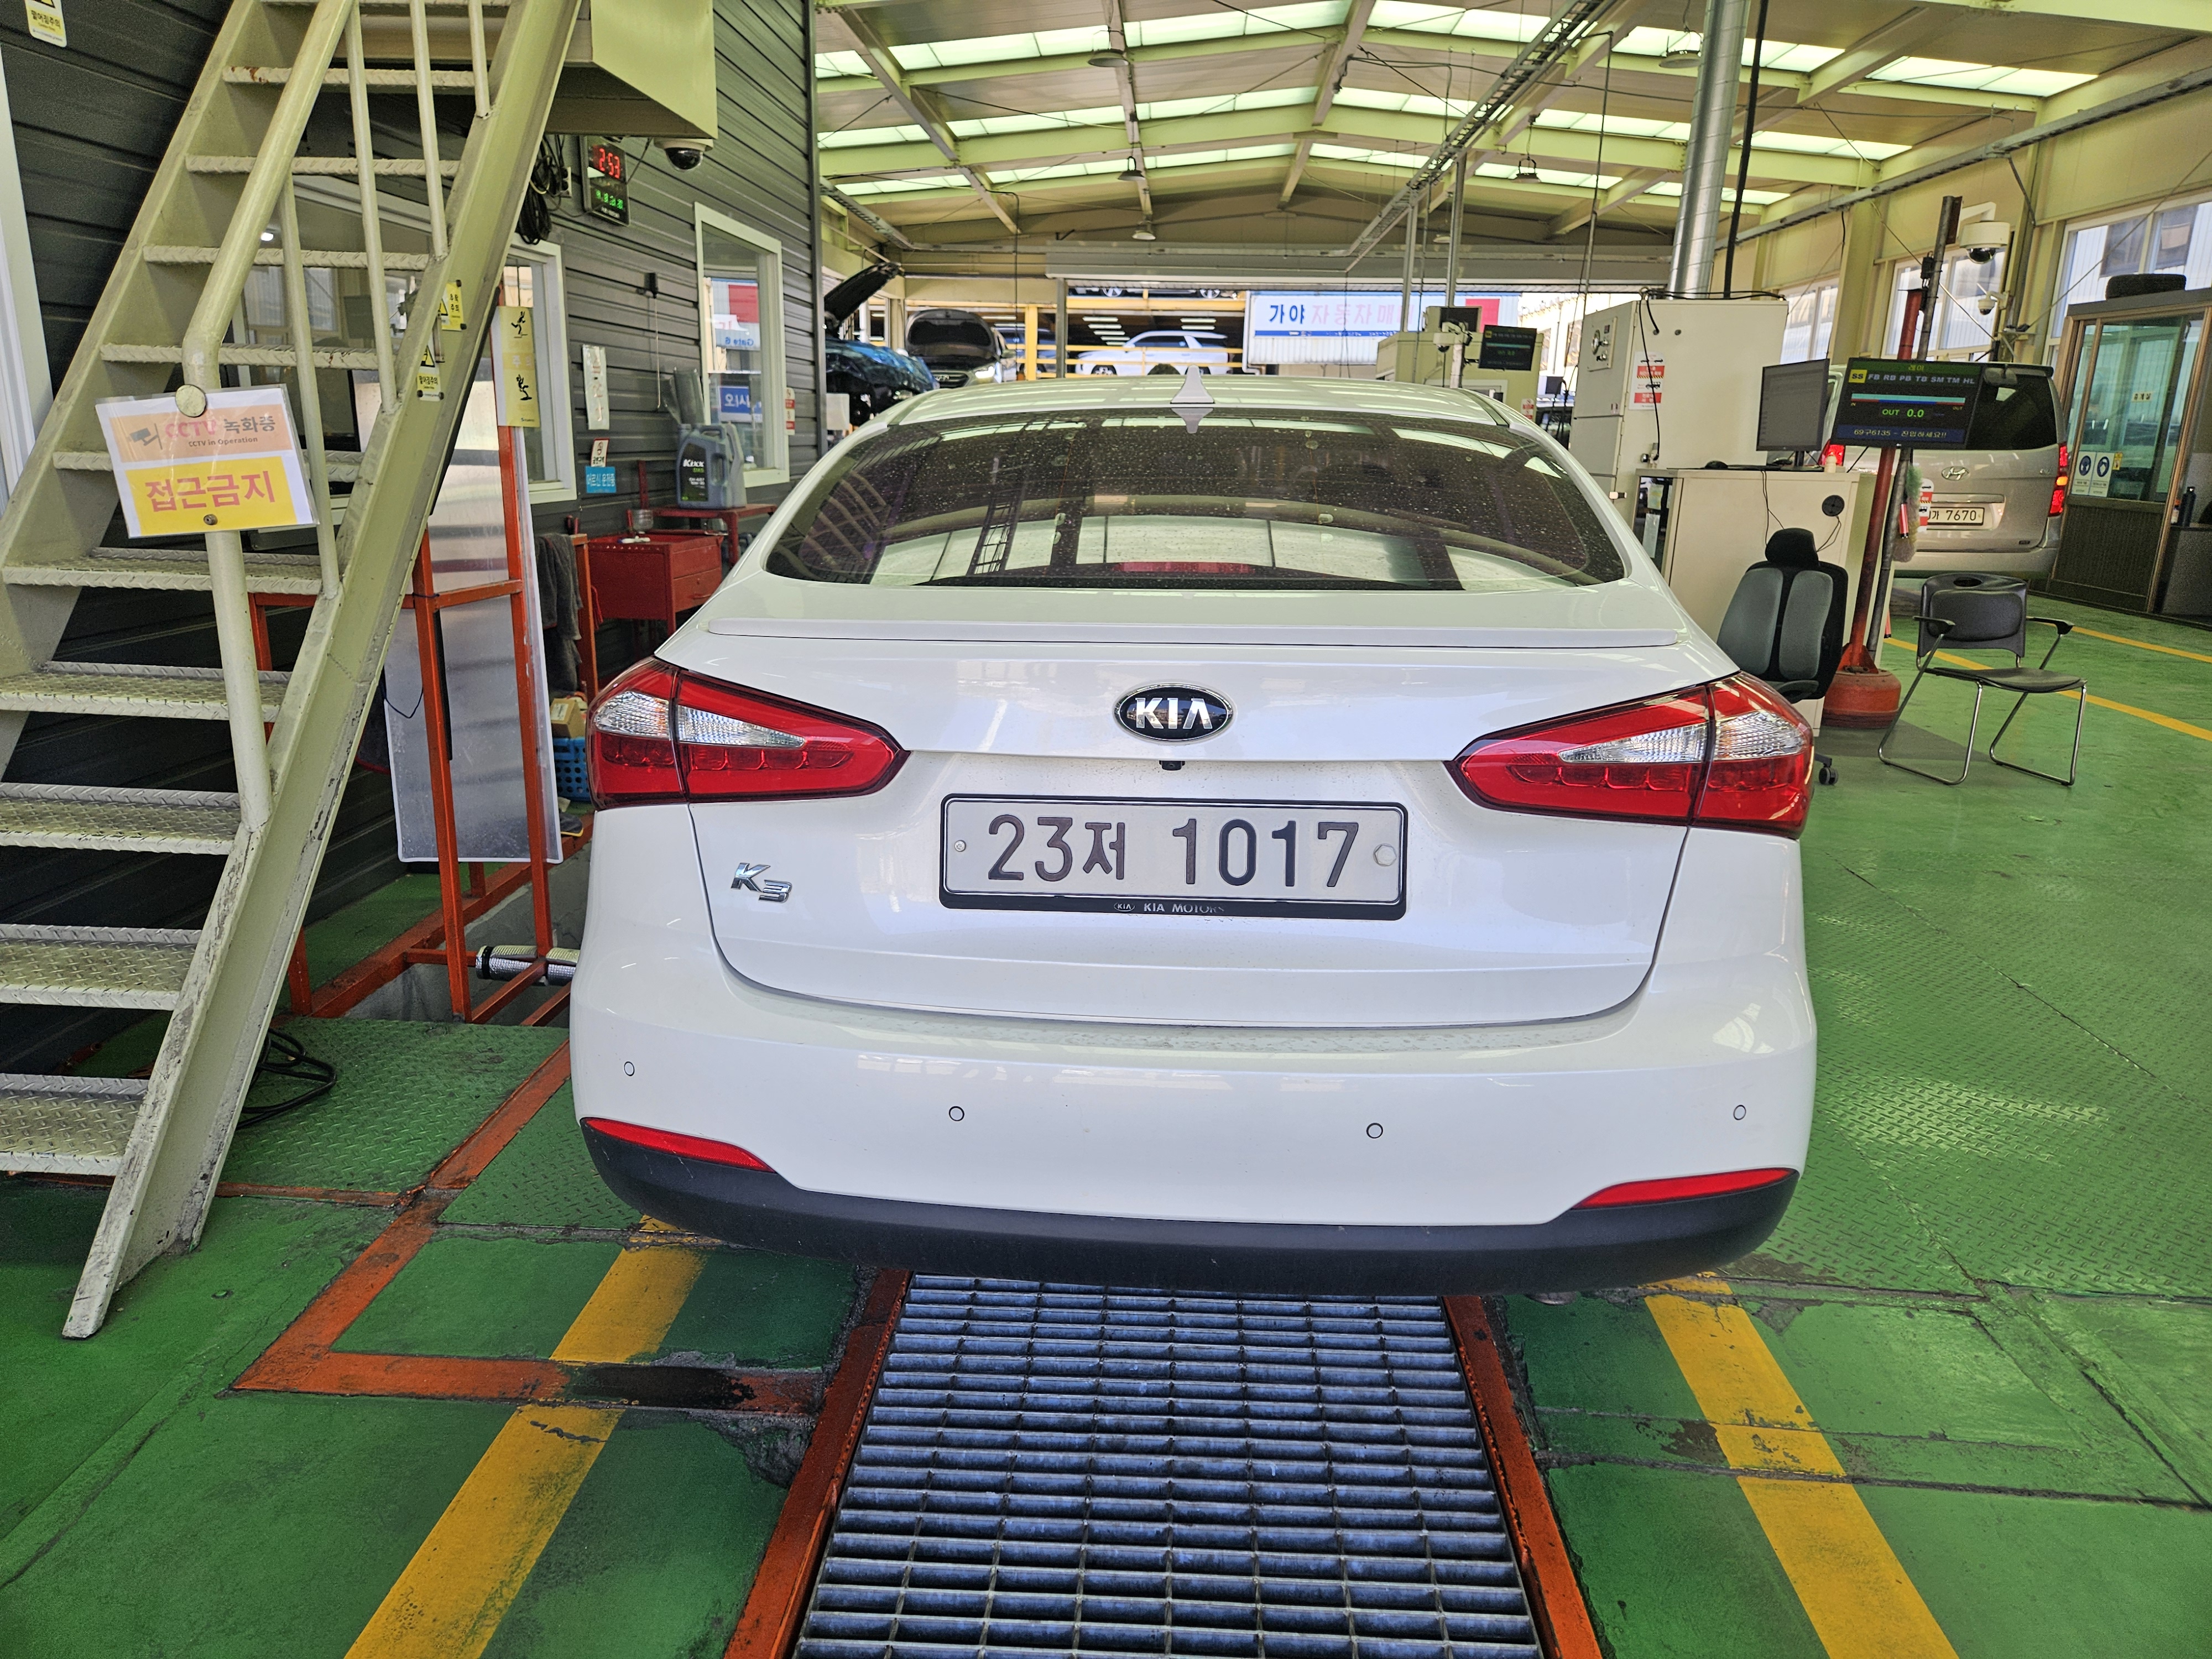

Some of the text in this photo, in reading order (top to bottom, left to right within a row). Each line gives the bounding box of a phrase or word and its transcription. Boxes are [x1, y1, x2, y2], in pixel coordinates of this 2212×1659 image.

[31, 10, 61, 29] 떨어짐주의
[450, 304, 460, 312] 주의
[1269, 304, 1306, 325] 가야
[419, 375, 438, 385] 떨어짐주의
[1907, 409, 1924, 418] 0.0
[165, 416, 276, 439] CCTV 녹화중
[218, 436, 258, 446] Operation
[683, 459, 705, 467] Kixx
[144, 471, 275, 512] 접근금지
[1946, 510, 1976, 521] 7670
[1135, 698, 1213, 729] KIA
[988, 814, 1359, 887] 23저 1017
[731, 862, 792, 904] K3
[1144, 902, 1165, 912] KIA
